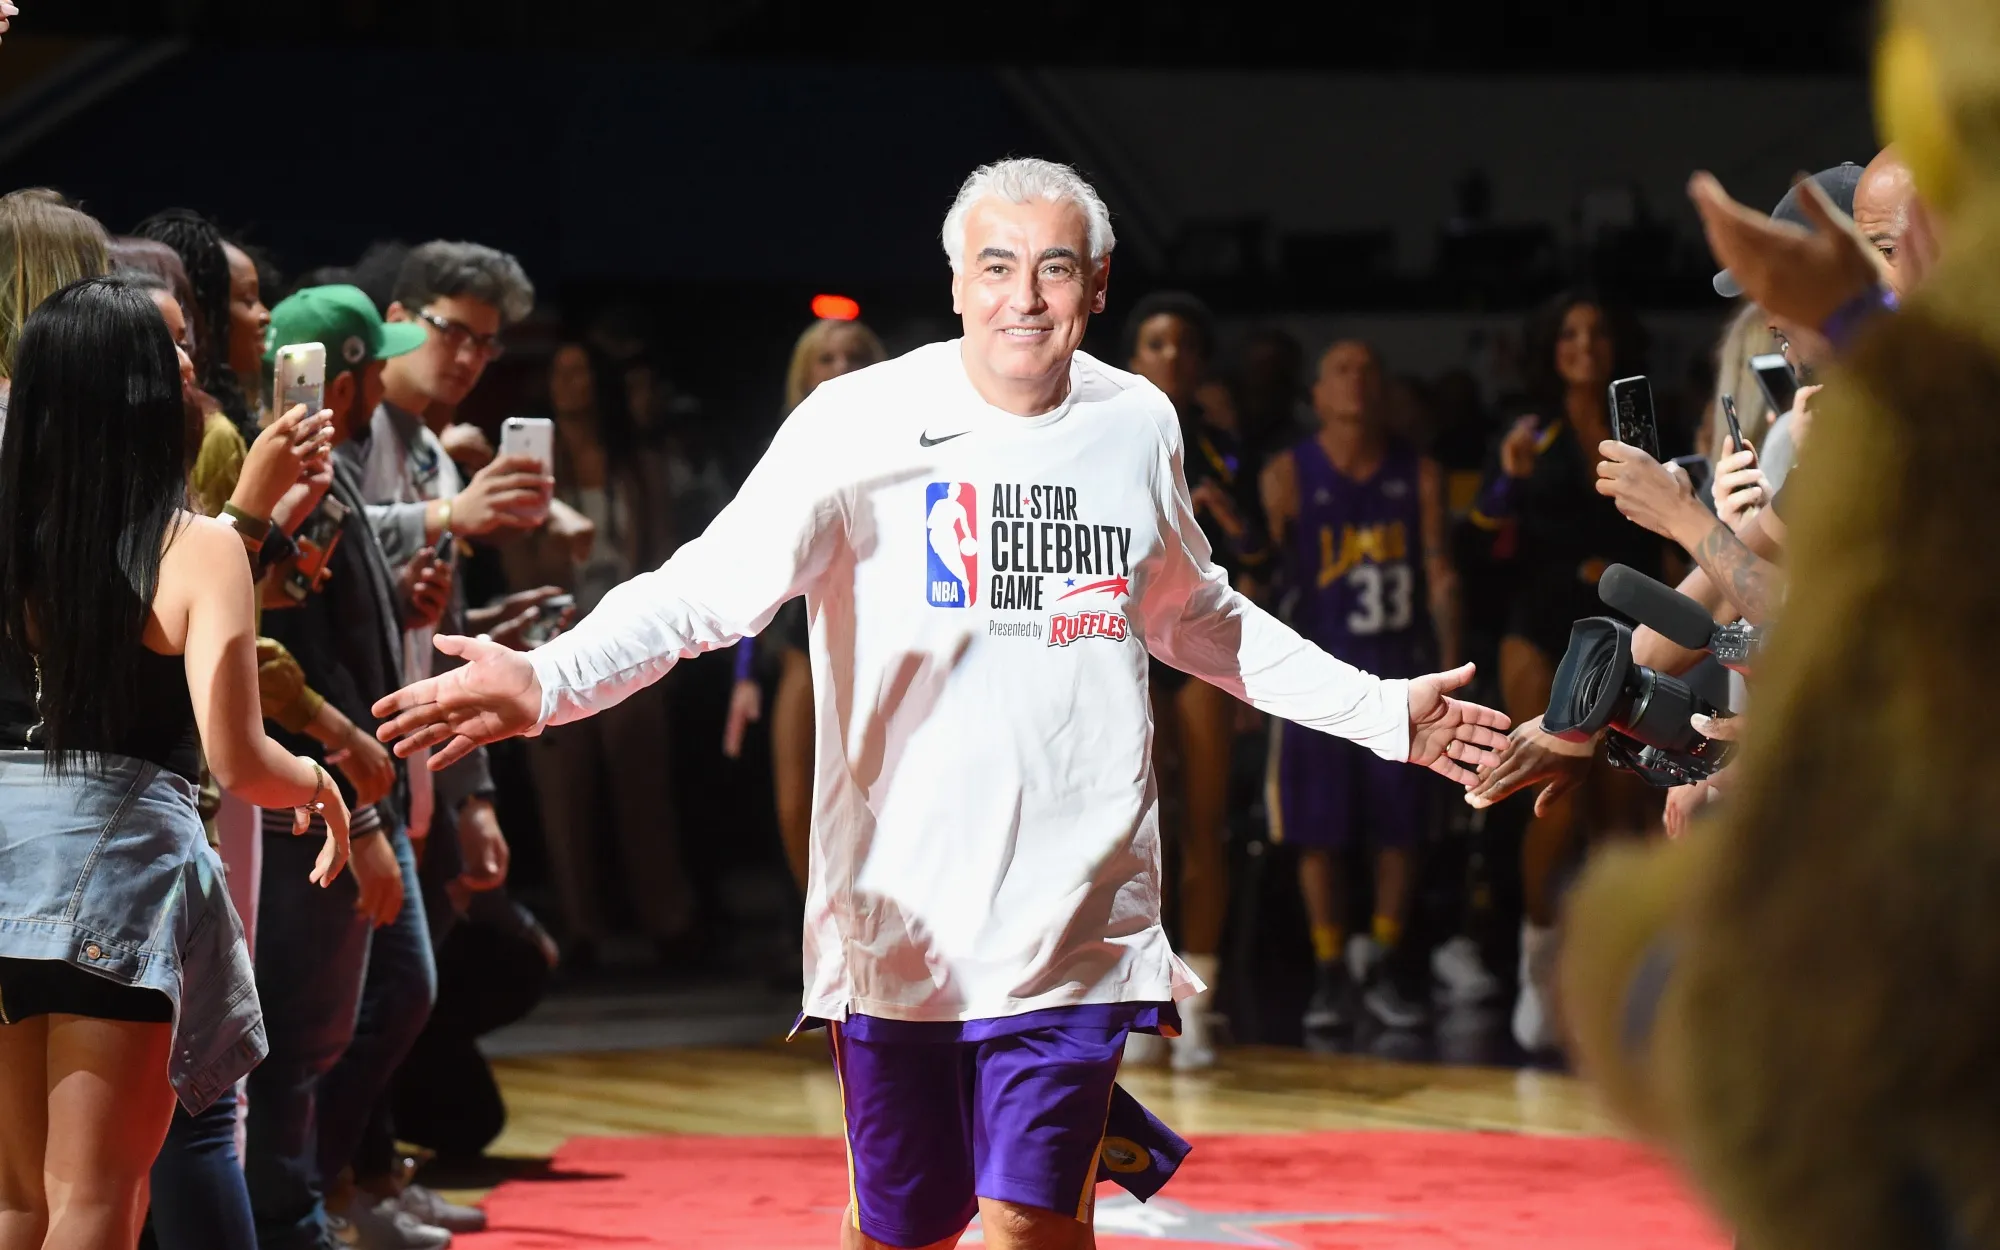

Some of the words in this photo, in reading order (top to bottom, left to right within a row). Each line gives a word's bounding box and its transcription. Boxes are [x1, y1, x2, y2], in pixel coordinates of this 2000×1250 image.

[991, 520, 1131, 577] CELEBRITY
[931, 581, 959, 603] NBA
[990, 574, 1044, 611] GAME
[1347, 563, 1413, 635] 33
[989, 619, 1031, 637] Presented
[1033, 619, 1043, 640] by
[1049, 611, 1128, 646] RUFFLES
